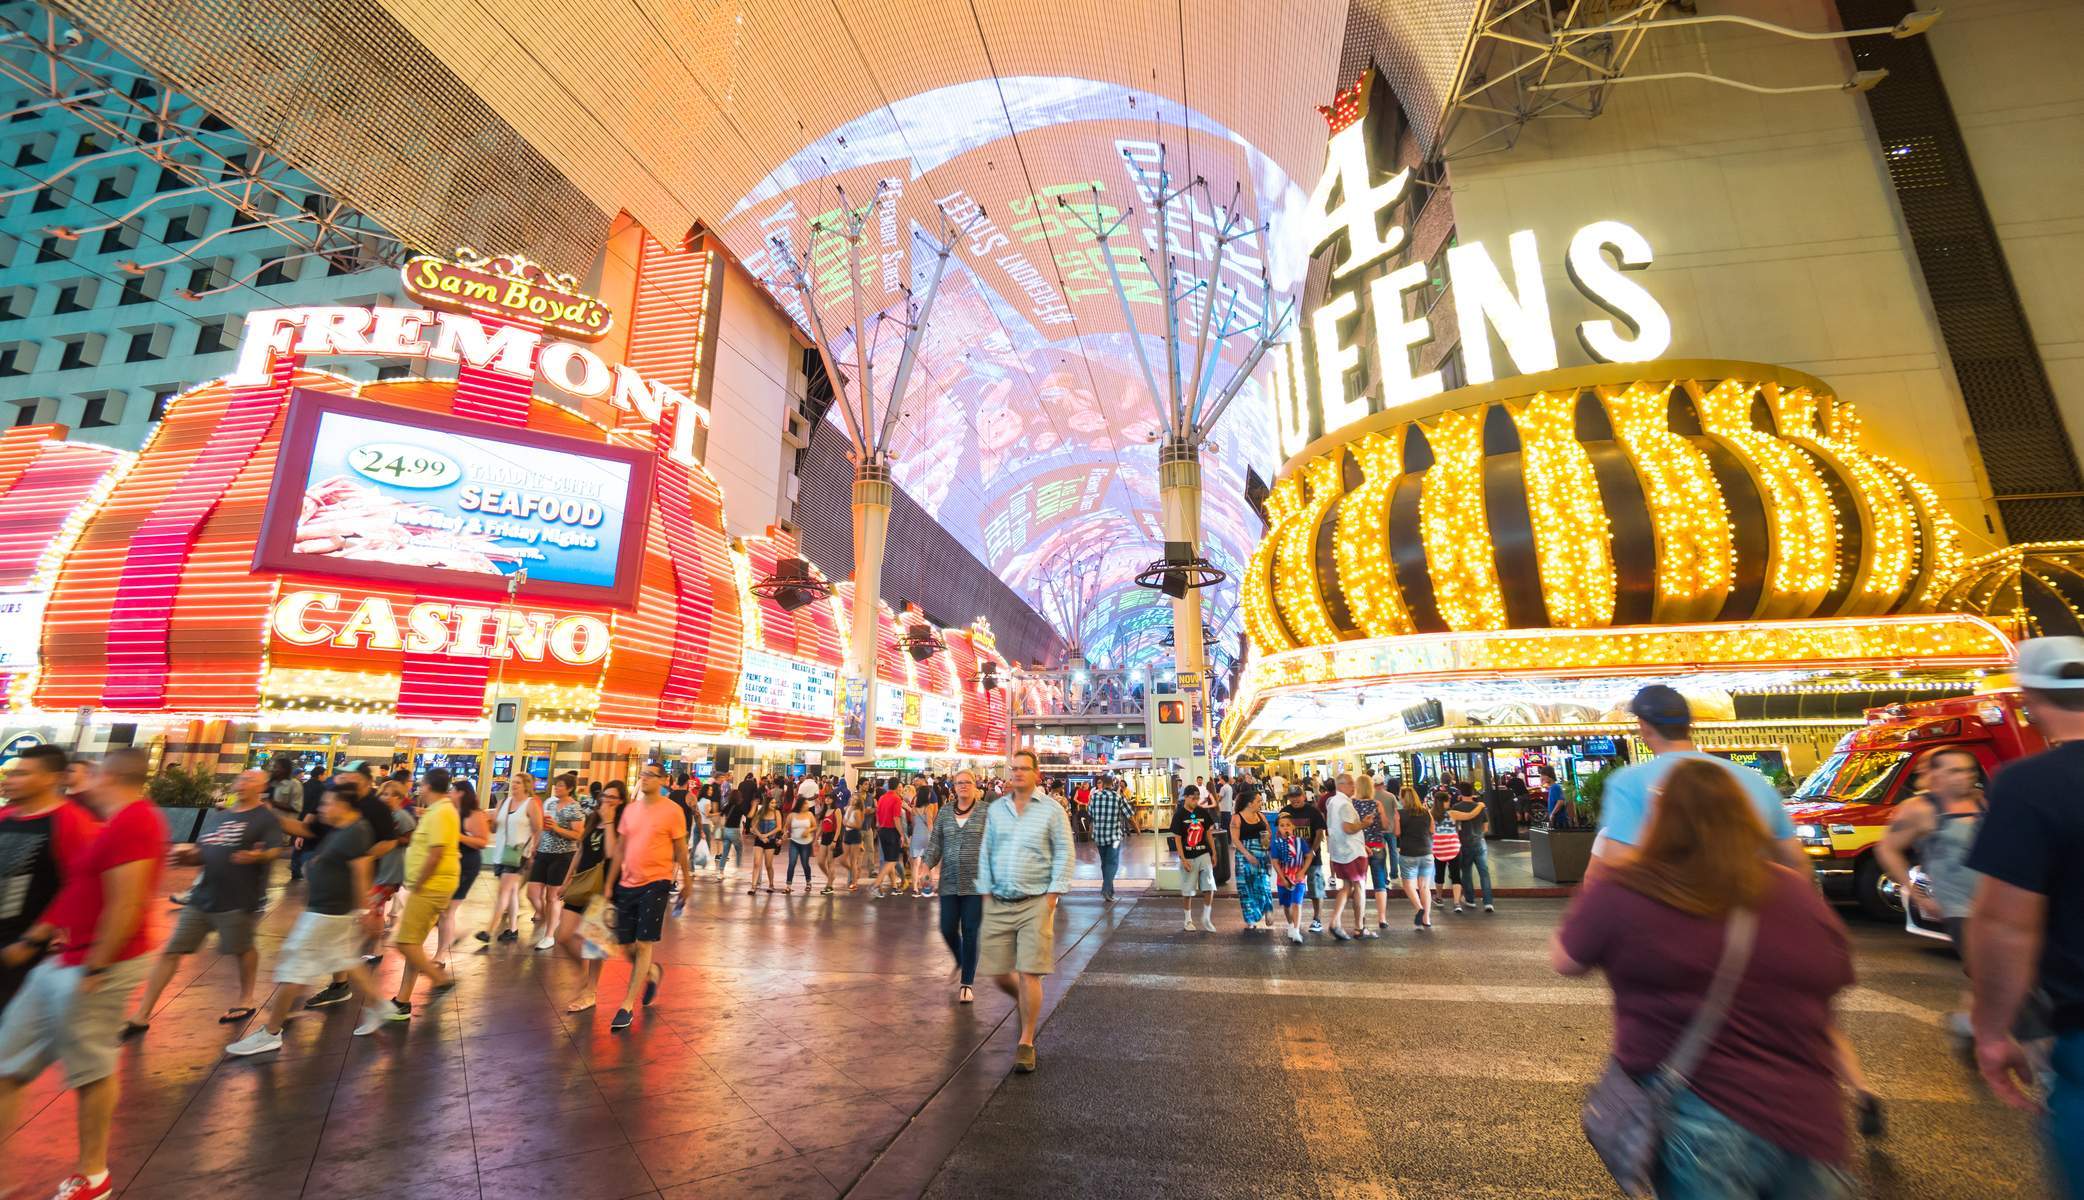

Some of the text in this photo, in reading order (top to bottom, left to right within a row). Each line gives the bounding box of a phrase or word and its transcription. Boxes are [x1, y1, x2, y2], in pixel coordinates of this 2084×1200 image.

[1308, 117, 1412, 280] 4
[881, 250, 904, 294] STREET
[935, 190, 1077, 325] #FREMONT STREET
[1009, 193, 1109, 302] TAG US
[1042, 180, 1163, 305] NOW!
[415, 260, 603, 328] Sam Boyd's
[226, 305, 711, 465] FREMONT
[458, 484, 605, 527] SEAFOOD
[486, 519, 541, 543] Friday
[273, 590, 612, 665] CASINO
[1178, 674, 1200, 685] NOW
